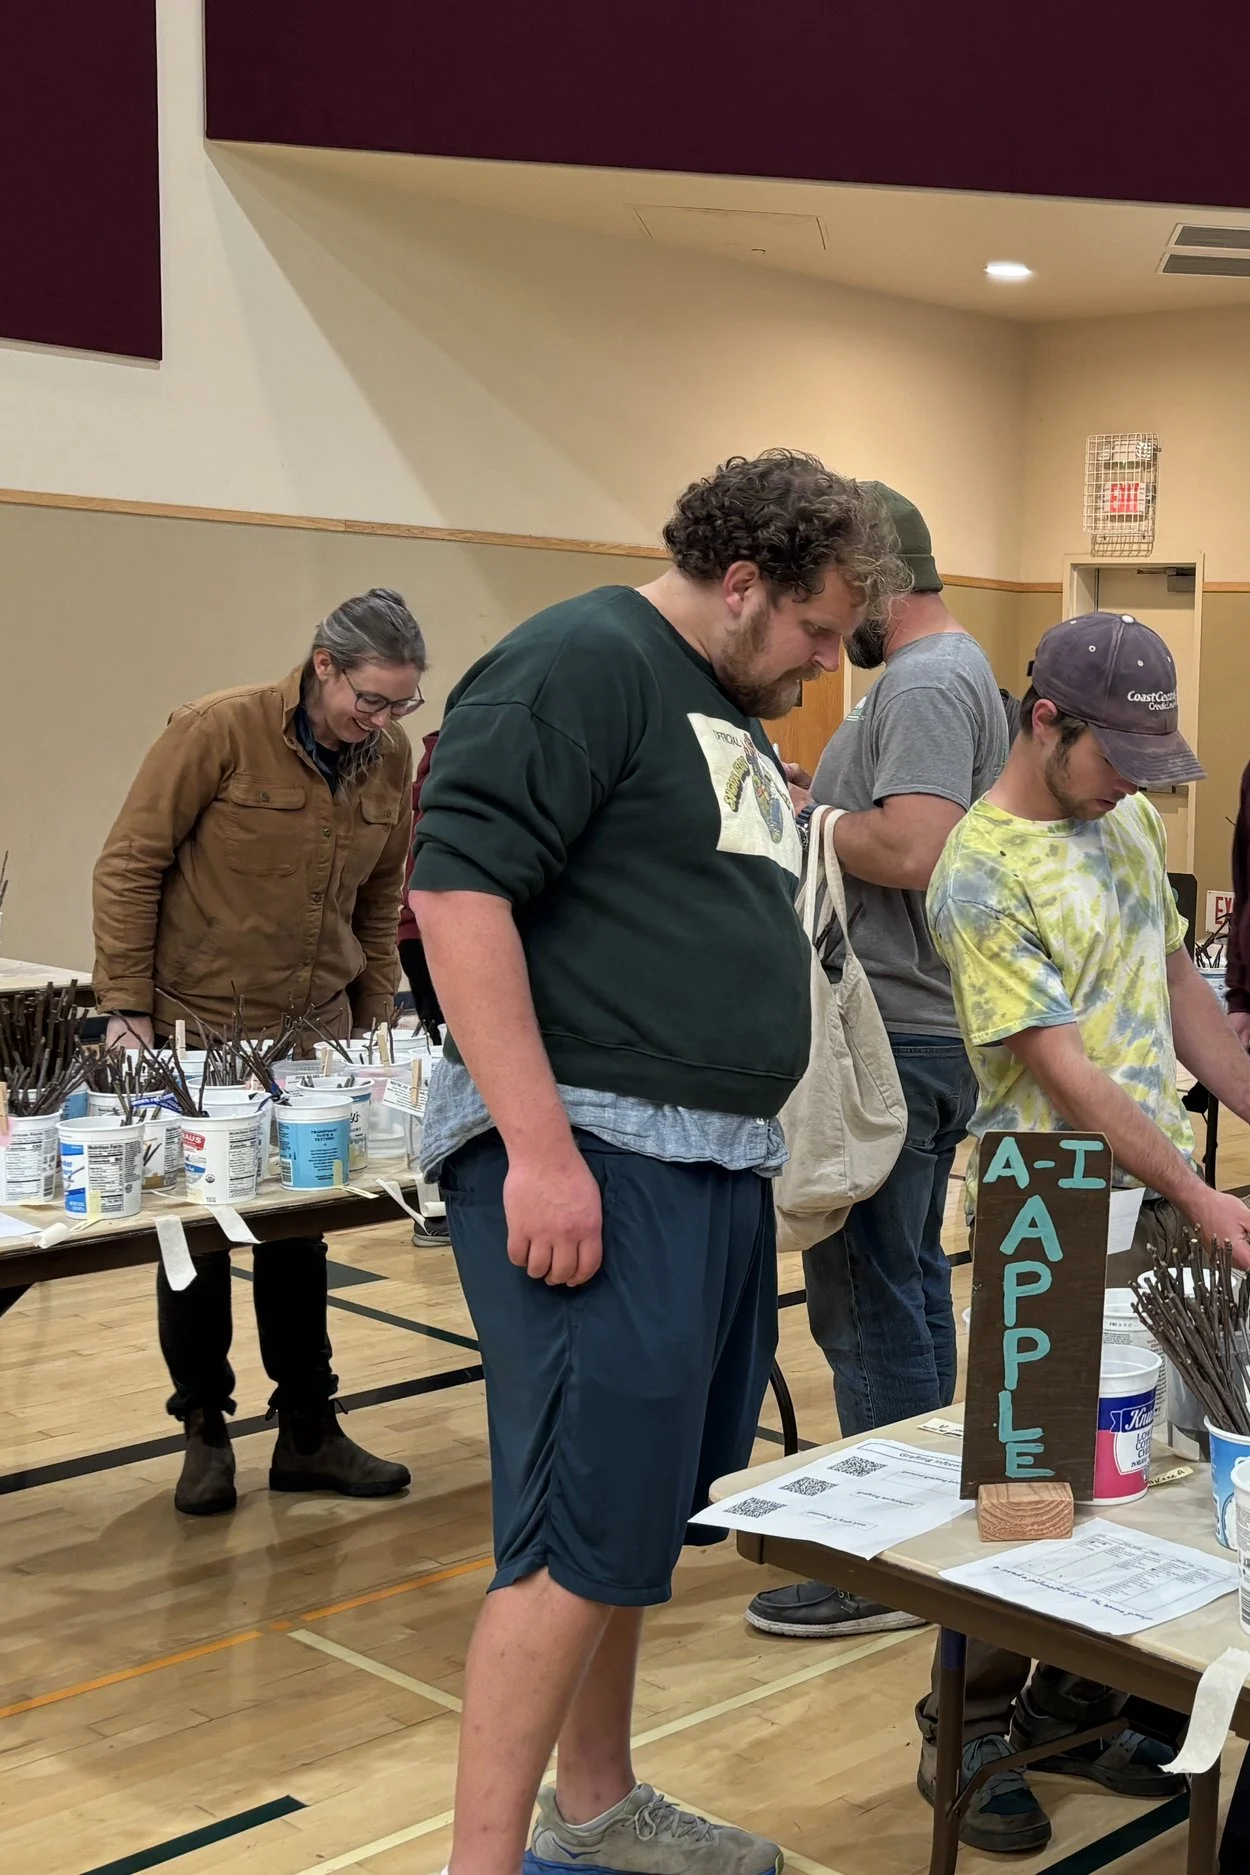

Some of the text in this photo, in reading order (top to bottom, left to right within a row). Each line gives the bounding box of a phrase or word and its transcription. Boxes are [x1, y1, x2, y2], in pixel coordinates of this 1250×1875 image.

[1110, 482, 1139, 512] EXIT
[983, 1136, 1106, 1190] A-I
[998, 1195, 1063, 1478] APPLE
[899, 1452, 961, 1468] Grafting Inform
